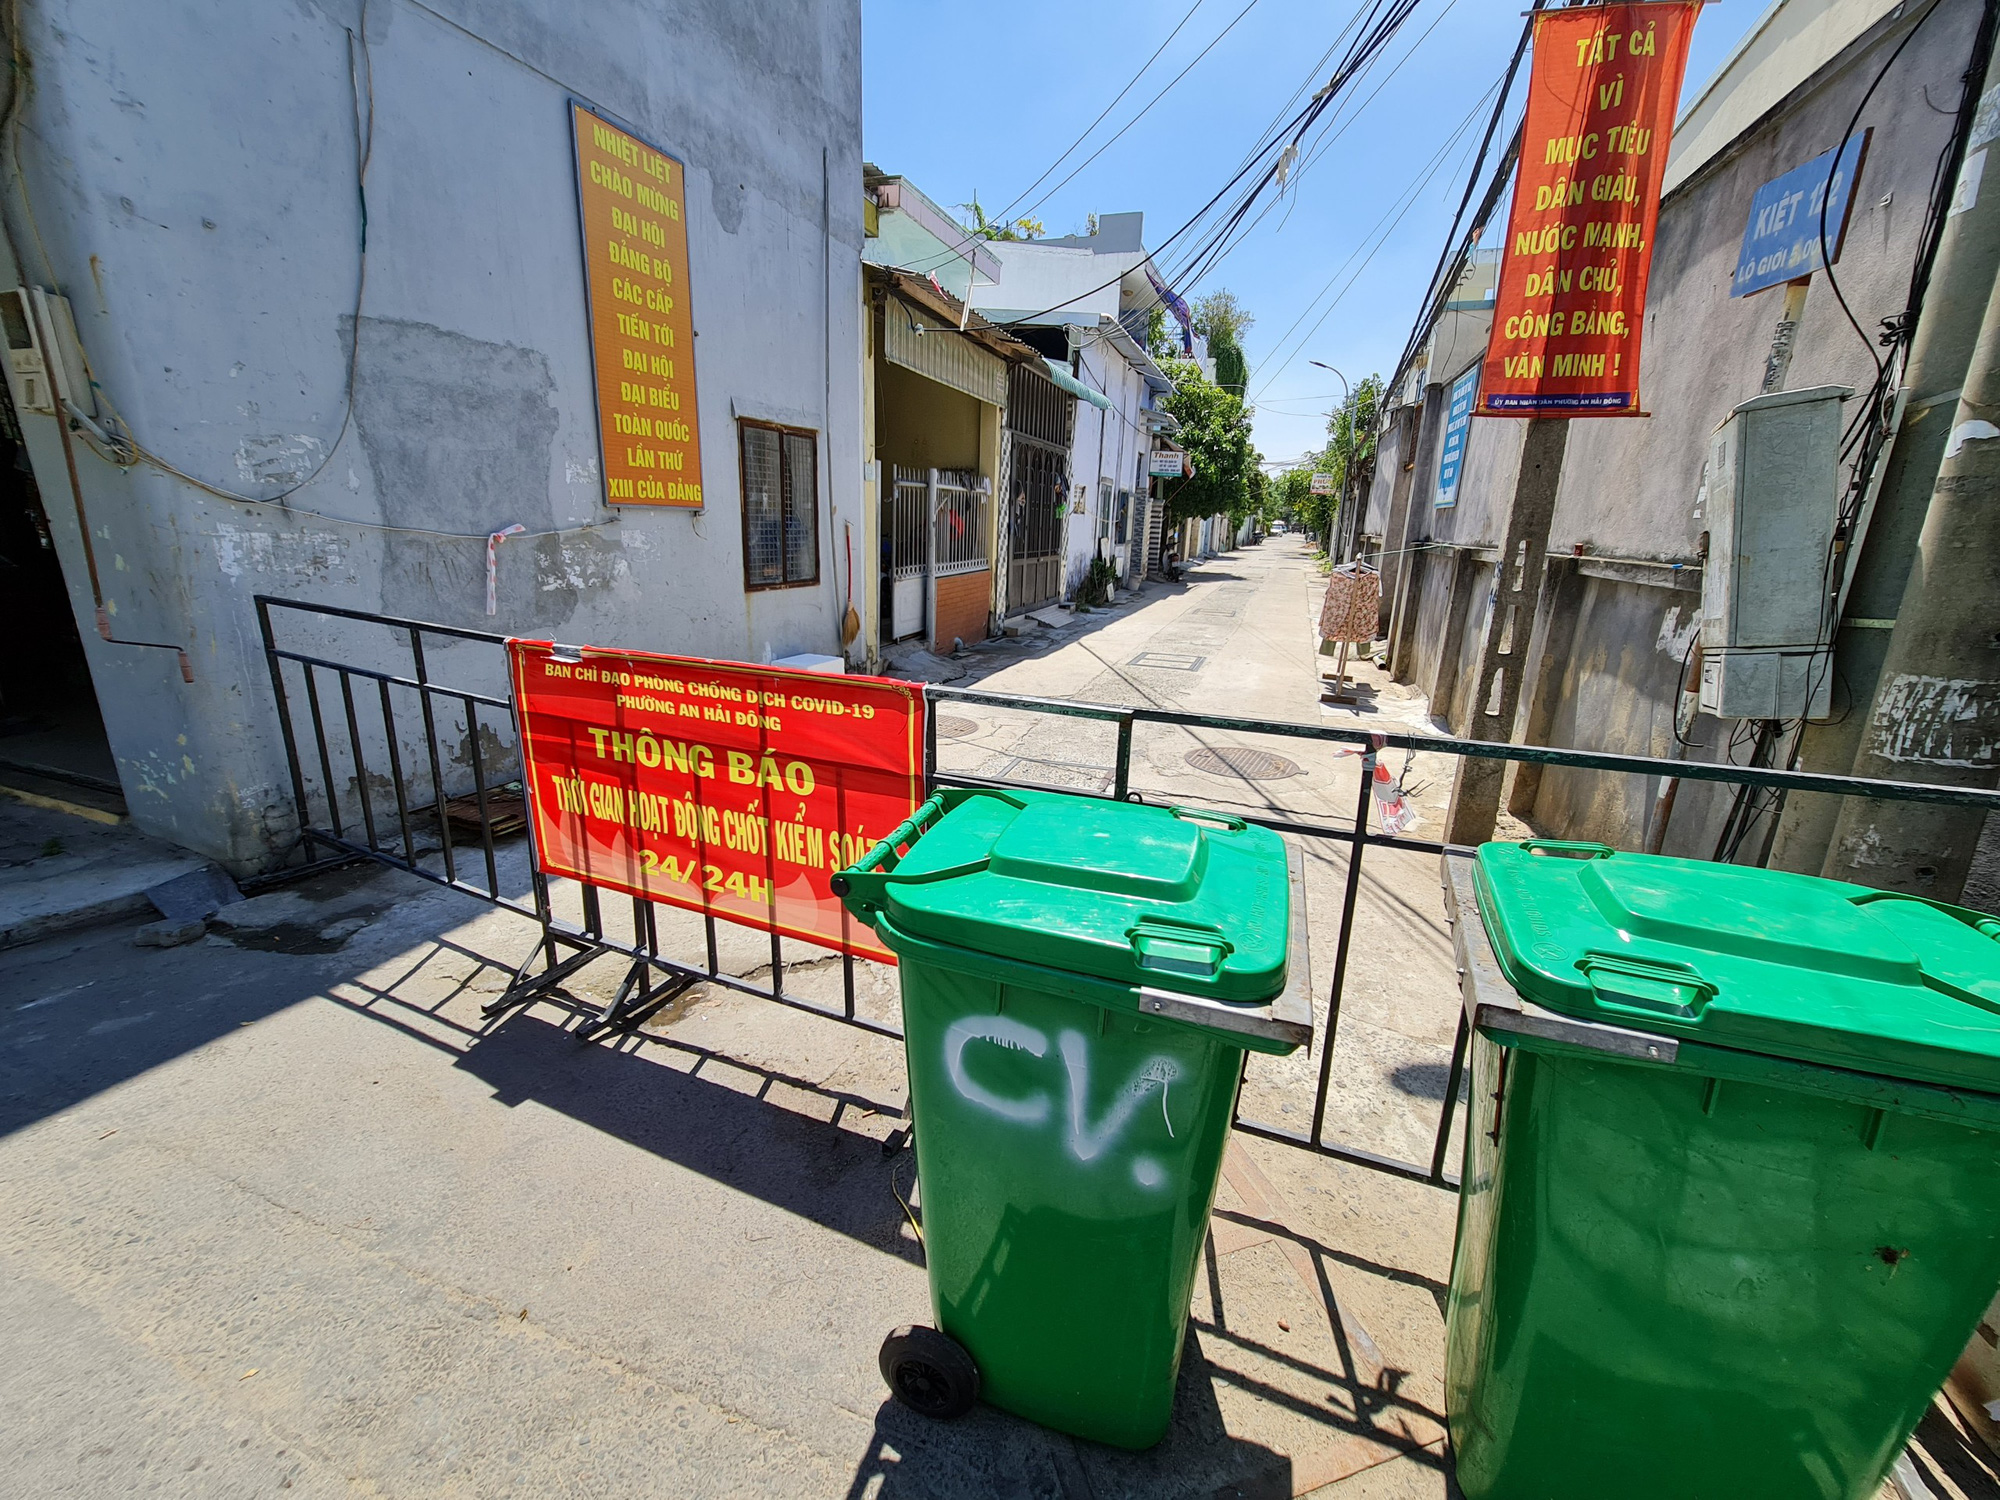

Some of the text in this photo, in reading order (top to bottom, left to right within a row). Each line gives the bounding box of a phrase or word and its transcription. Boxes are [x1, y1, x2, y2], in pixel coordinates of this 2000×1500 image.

[1576, 20, 1656, 67] TẤT CẢ
[1599, 73, 1624, 110] VÌ
[593, 123, 671, 184] NHIỆT LIỆT
[1545, 119, 1651, 167] MỤC TIÊU
[590, 160, 679, 222] CHÀO MỪNG
[1535, 167, 1640, 211] DÂN GIÀU,
[612, 206, 665, 249] ĐẠI HỘI
[1754, 191, 1805, 241] KIỆT
[1514, 221, 1645, 256] NƯỚC MẠNH,
[609, 239, 672, 287] ĐẢNG BỘ
[1525, 258, 1622, 297] DÂN CHỦ,
[1737, 258, 1756, 284] LỘ
[1757, 247, 1788, 275] GIỚI
[612, 278, 674, 315] CÁC CẤP
[616, 312, 675, 348] TIẾN TỚI
[1505, 300, 1630, 339] CÔNG BẰNG,
[622, 348, 674, 381] ĐẠI HỘI
[1504, 352, 1621, 379] VĂN MINH !
[620, 381, 680, 411] ĐẠI BIỂU
[613, 412, 690, 443] TOÀN QUỐC
[627, 443, 684, 471] LẦN THỨ
[609, 475, 702, 502] XIII CỦA ĐẢNG
[545, 663, 875, 719] BAN CHỈ ĐẠO PHÒNG CHỐNG DỊCH COVID-19
[616, 694, 782, 732] PHƯỜNG AN HẢI ĐÔNG
[588, 727, 816, 796] THÔNG BÁO
[552, 768, 591, 818] THỜI
[590, 781, 625, 825] GIAN
[629, 784, 670, 840] HOẠT
[672, 791, 721, 848] ĐỘNG
[723, 800, 769, 857] CHỐT
[775, 802, 825, 869] KIỂM
[638, 849, 775, 907] 24/ 24H
